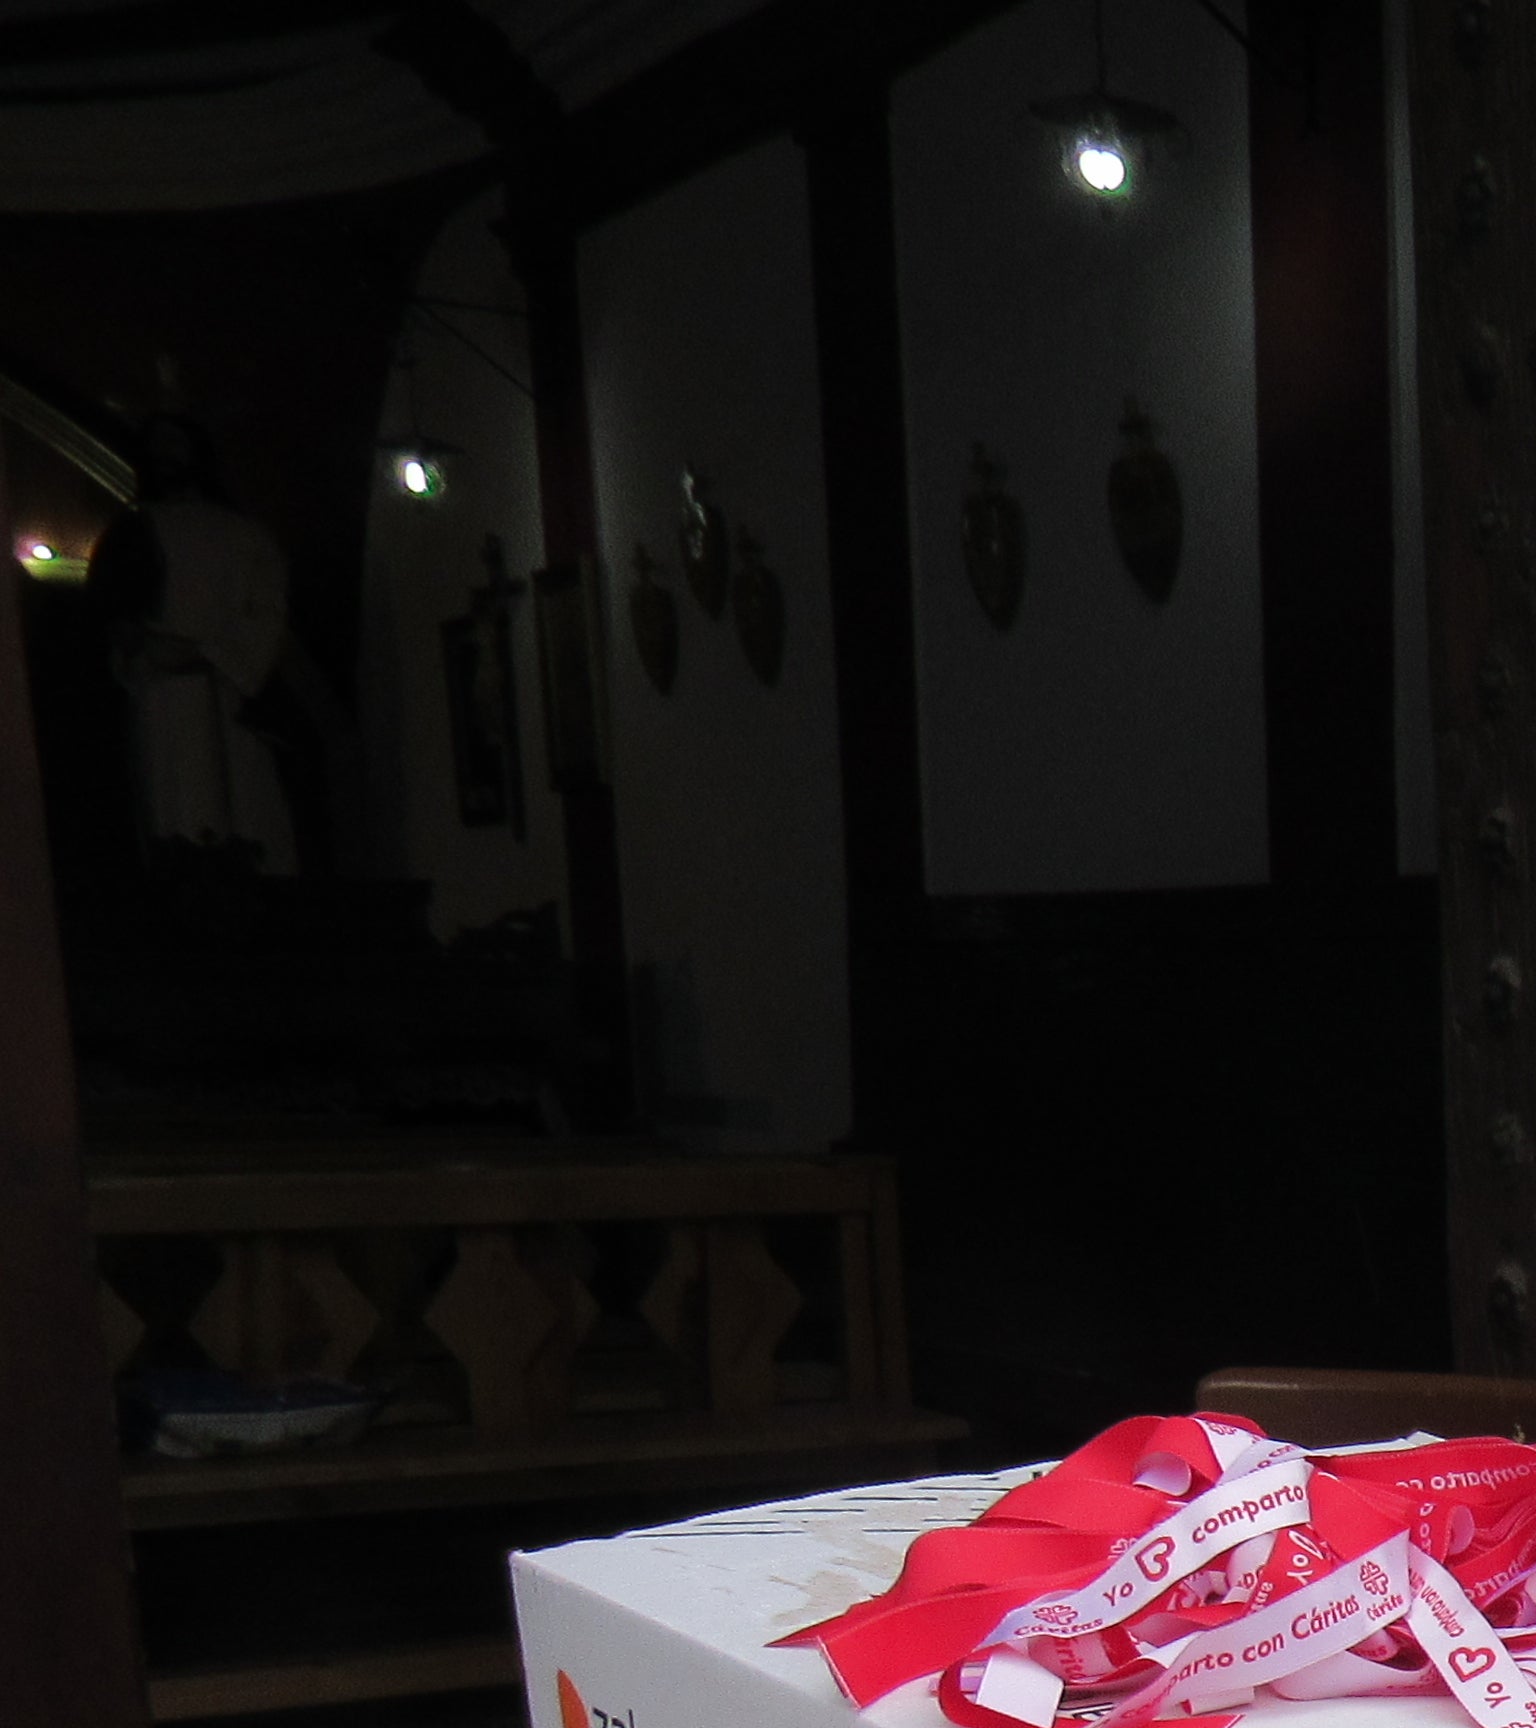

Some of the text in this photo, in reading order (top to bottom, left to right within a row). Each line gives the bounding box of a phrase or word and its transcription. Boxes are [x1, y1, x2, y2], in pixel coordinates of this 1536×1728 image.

[1103, 1485, 1304, 1607] Yo comparto
[1242, 1632, 1285, 1663] con
[1291, 1593, 1361, 1640] Cáritas
[1484, 1682, 1512, 1709] Yo
